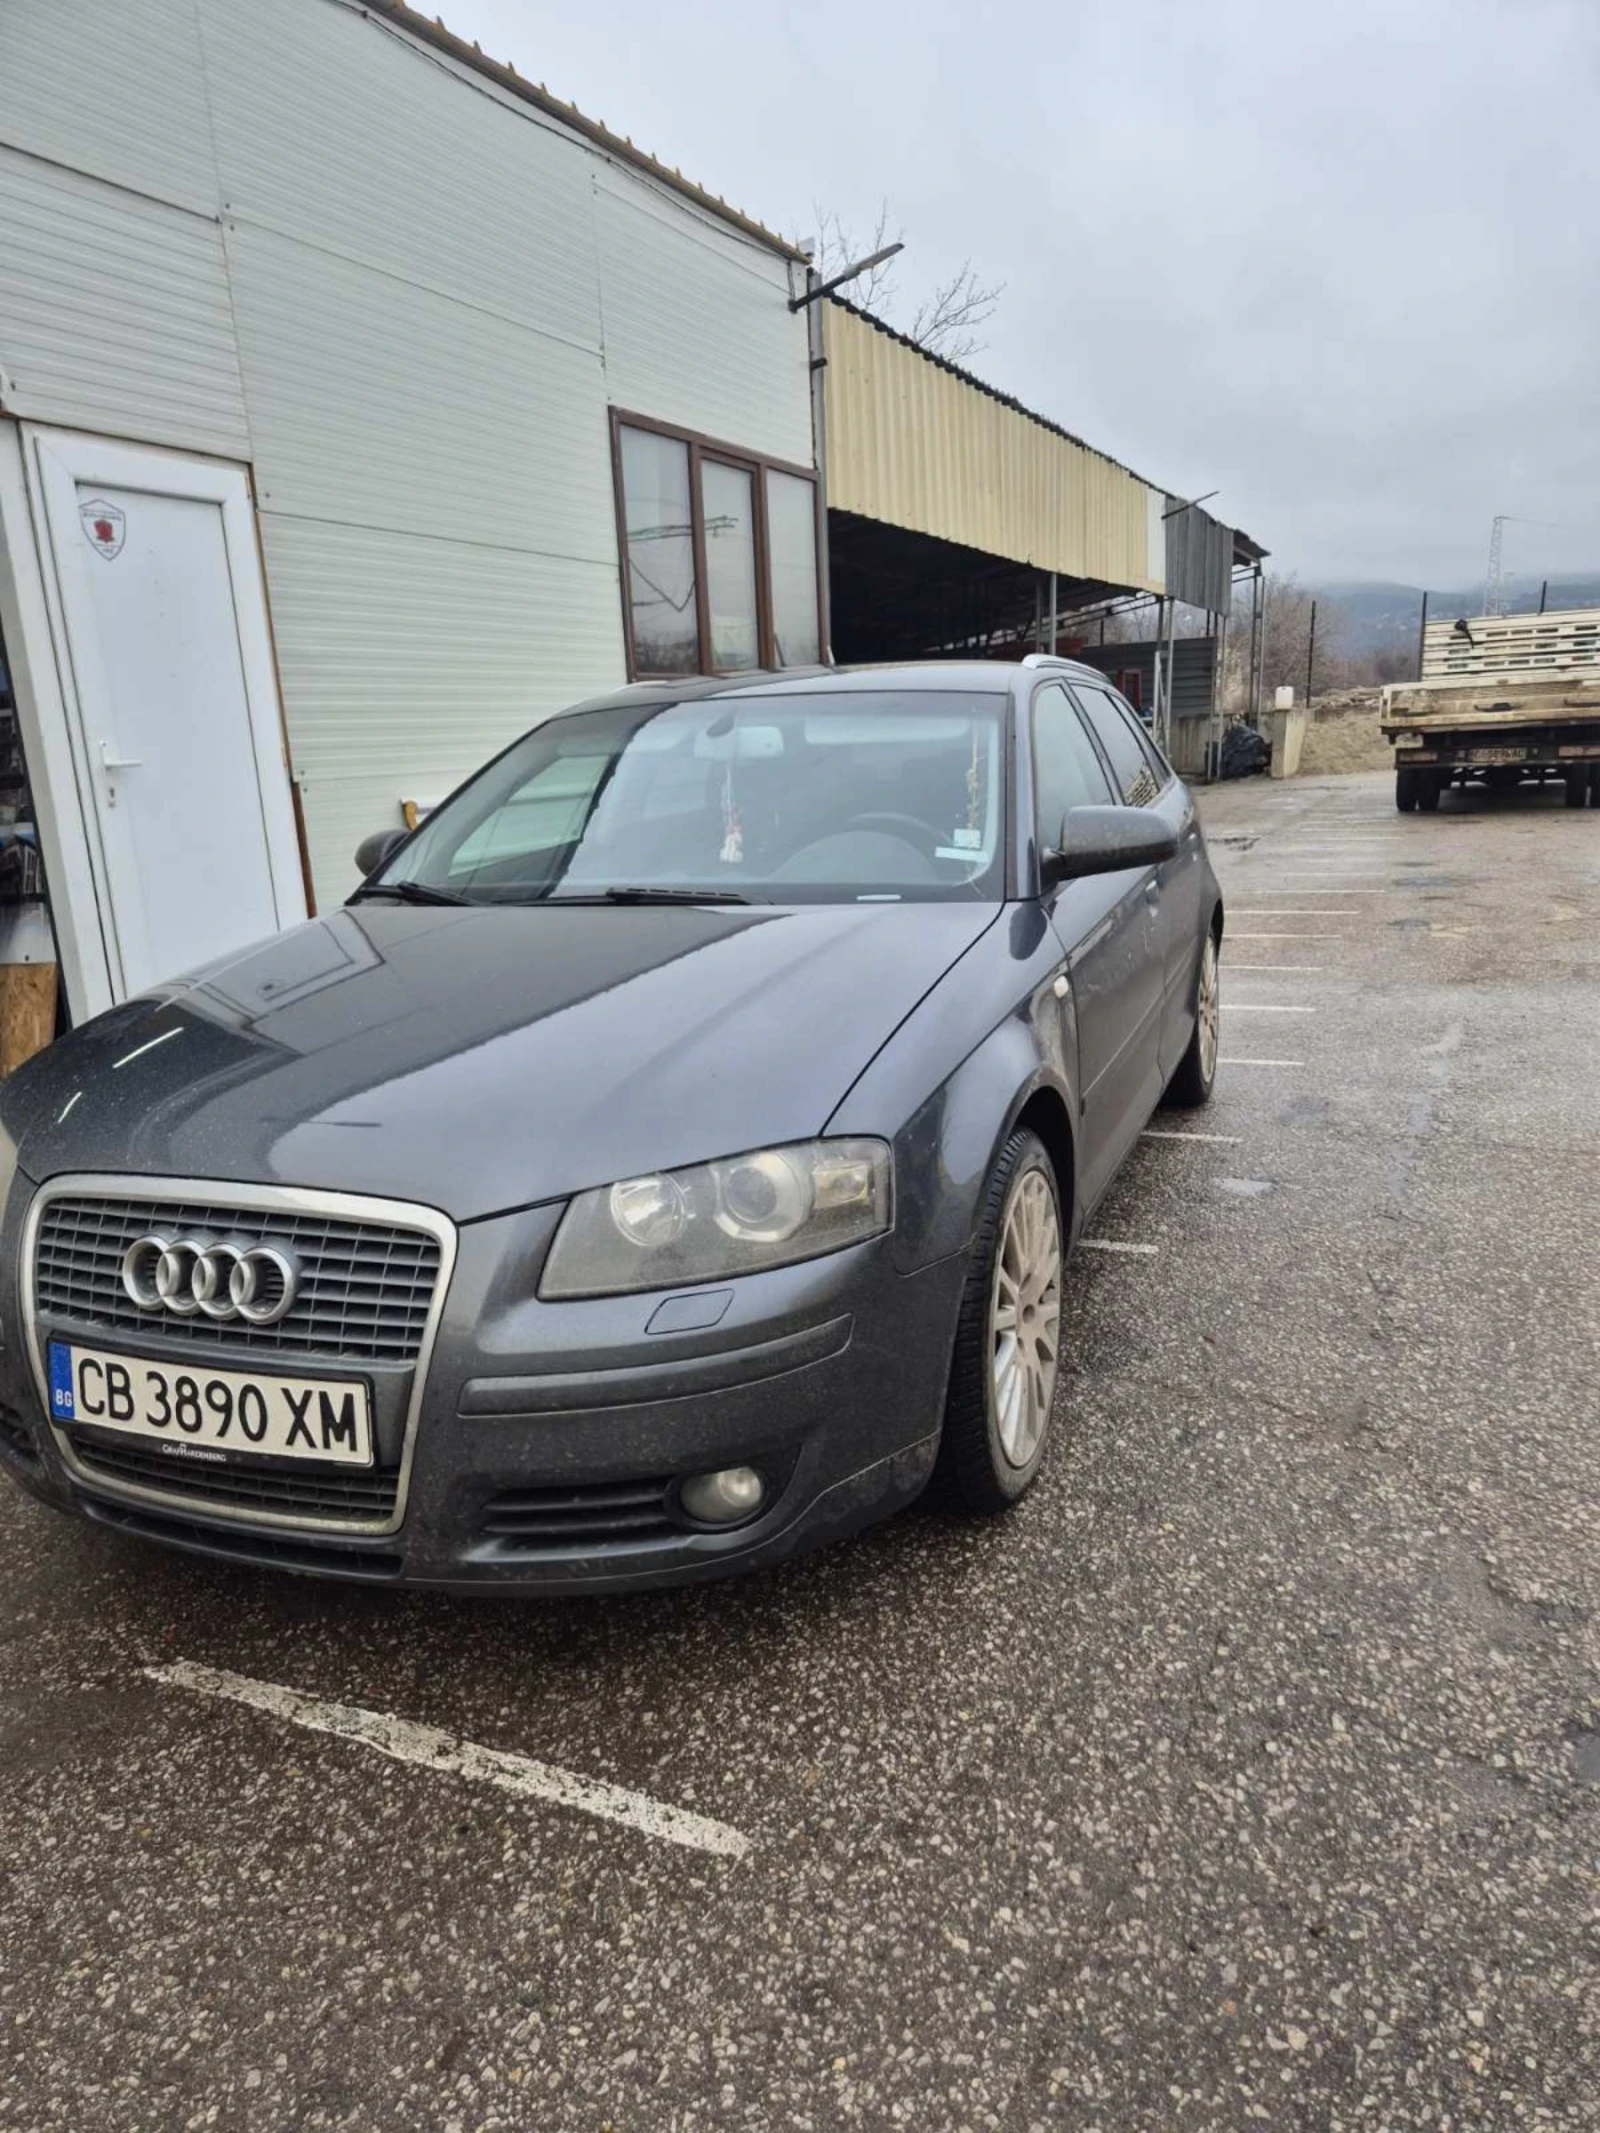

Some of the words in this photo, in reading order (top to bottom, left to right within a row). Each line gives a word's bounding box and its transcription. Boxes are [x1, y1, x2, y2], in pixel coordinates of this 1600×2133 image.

[56, 1388, 73, 1407] BG
[78, 1357, 135, 1421] CB
[146, 1371, 268, 1442] 3890
[281, 1387, 358, 1452] XM
